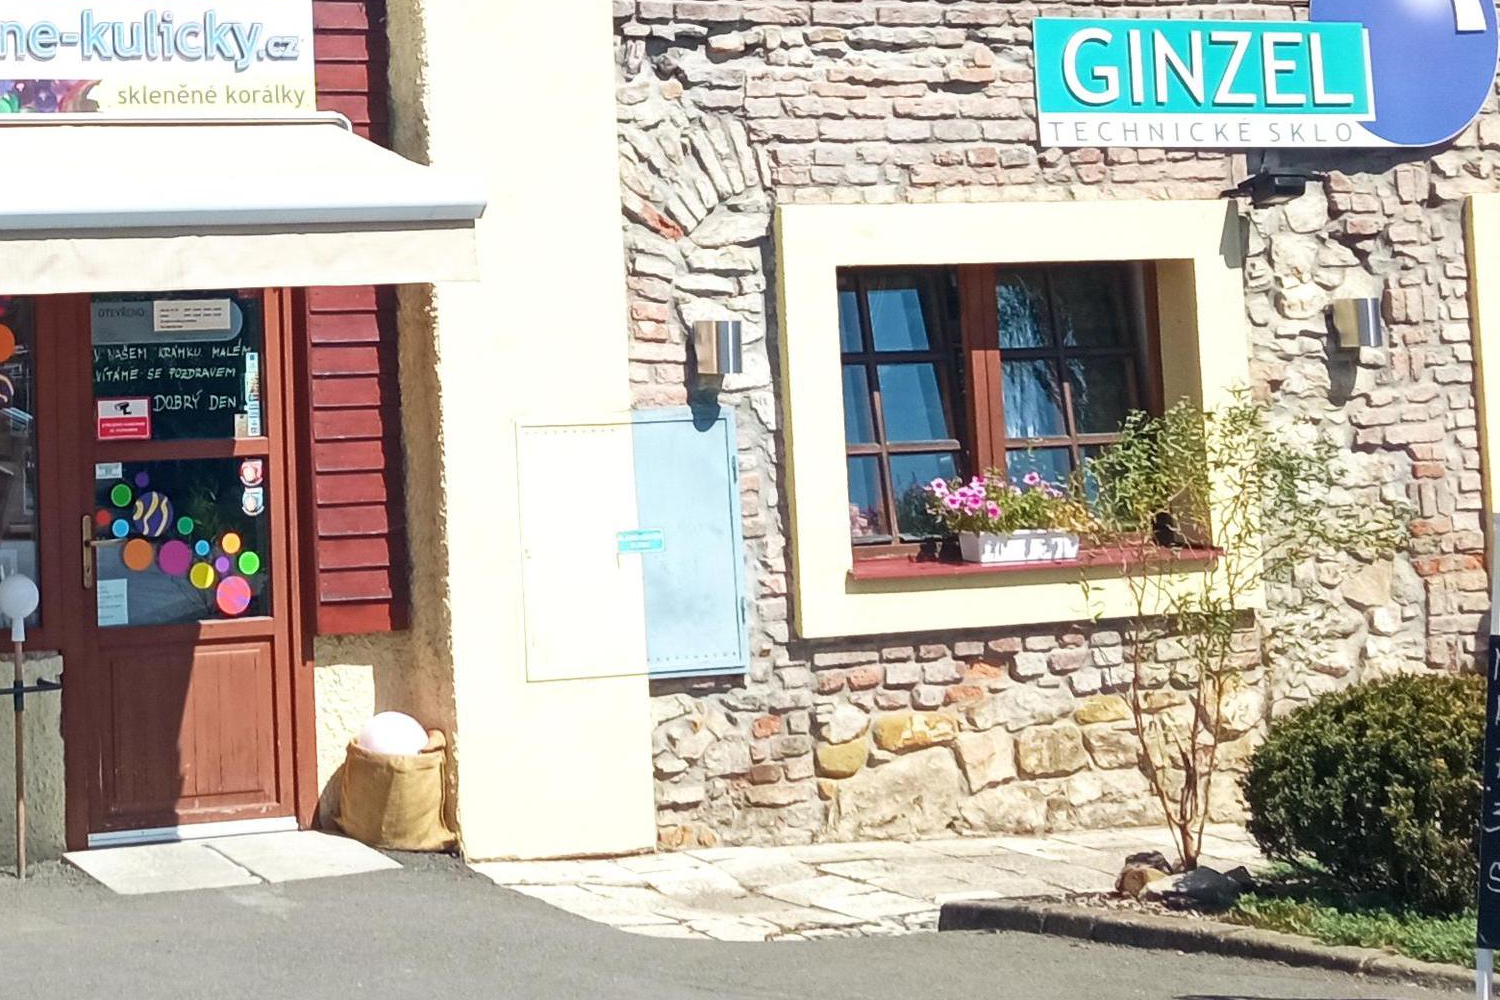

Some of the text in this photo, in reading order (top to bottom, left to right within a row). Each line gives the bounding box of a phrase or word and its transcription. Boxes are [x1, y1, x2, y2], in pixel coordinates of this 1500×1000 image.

[1061, 27, 1355, 107] GINZEL
[117, 83, 306, 108] skleněné korálky
[1047, 117, 1353, 143] TECHNICKÉ SKLO
[146, 367, 162, 380] SE
[153, 389, 237, 412] DOBRÝ DEN
